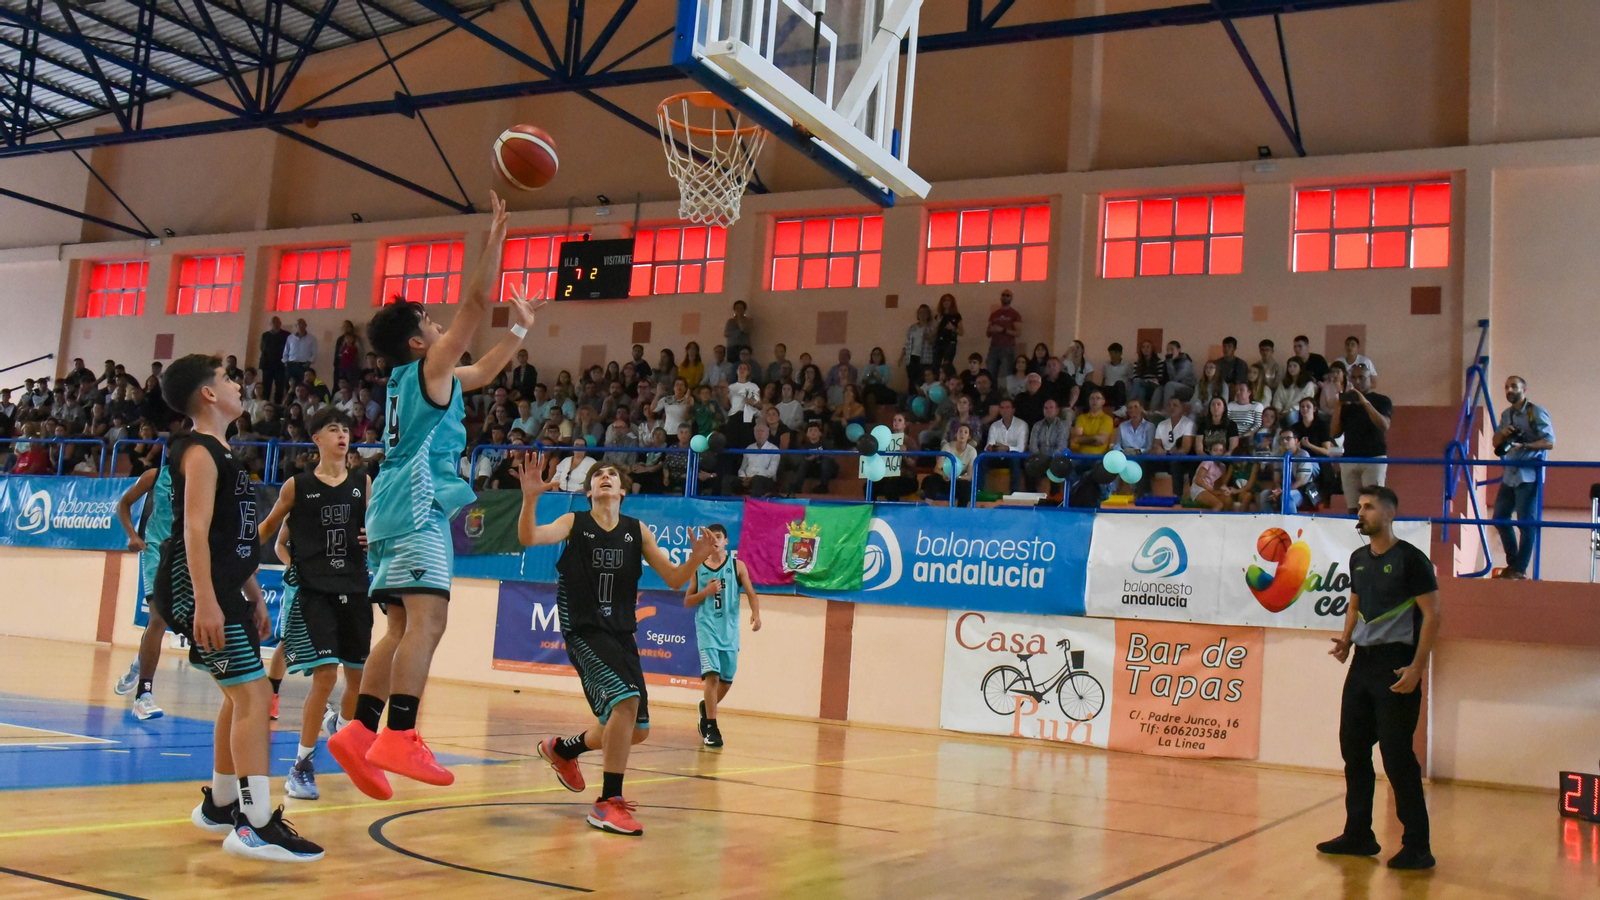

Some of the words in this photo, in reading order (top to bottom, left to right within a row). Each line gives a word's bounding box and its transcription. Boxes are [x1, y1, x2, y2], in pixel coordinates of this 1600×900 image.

[603, 255, 633, 266] VISITANTE
[575, 268, 582, 280] 7
[589, 267, 598, 280] 2
[564, 285, 573, 297] 2
[238, 501, 258, 541] 15
[326, 529, 347, 557] 12
[915, 529, 1057, 562] baloncesto
[599, 573, 614, 603] 11
[1123, 579, 1193, 596] baloncesto
[714, 592, 723, 610] 5
[646, 630, 686, 645] Seguros
[955, 612, 1048, 655] Casa
[637, 648, 672, 659] ARREÑO
[1125, 632, 1190, 665] Bar
[1201, 637, 1248, 669] de
[1126, 664, 1244, 706] Tapas
[1009, 695, 1094, 745] Puri
[1129, 710, 1144, 721] C/.
[1148, 711, 1181, 724] Padre
[1184, 715, 1221, 728] Junco,
[1226, 718, 1239, 729] 16
[1140, 722, 1159, 736] Tlf:
[1163, 725, 1227, 740] 606203588
[1158, 737, 1171, 747] La
[240, 789, 254, 806] NIKE
